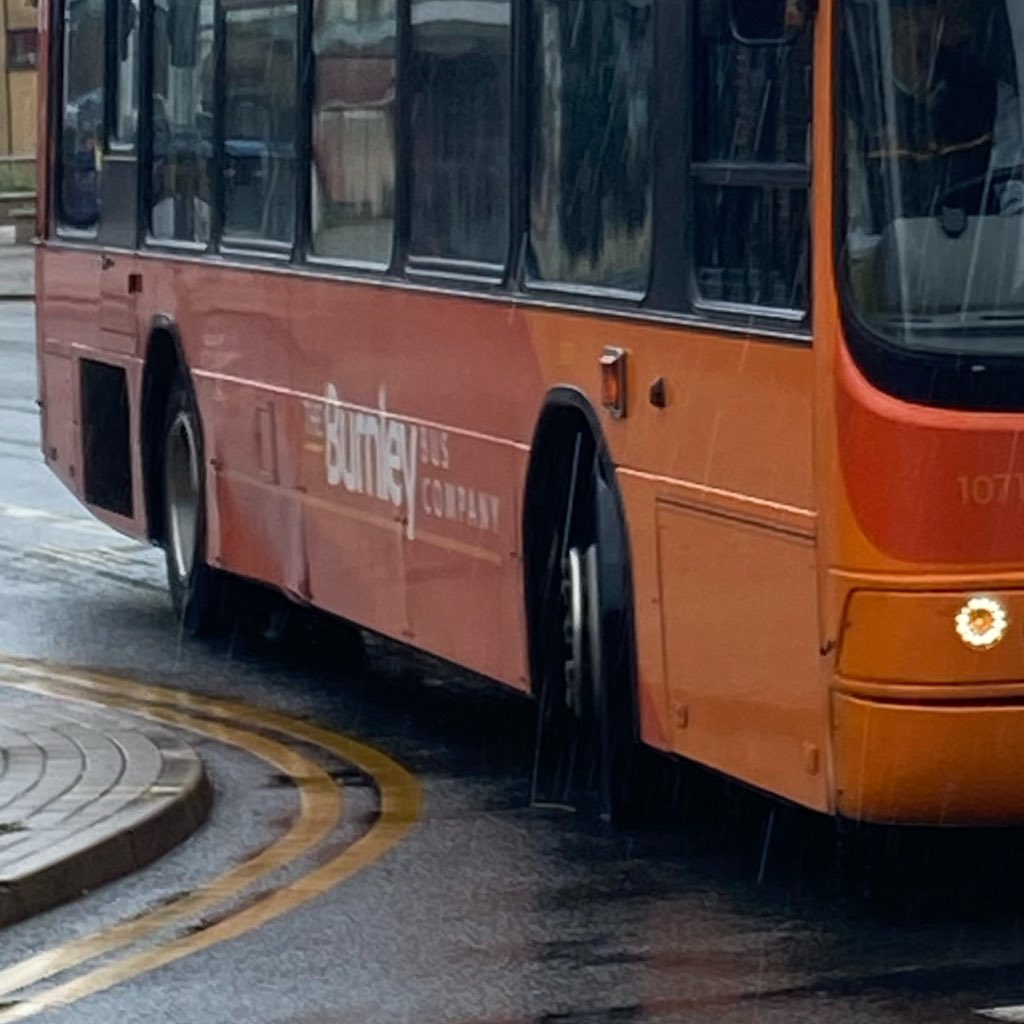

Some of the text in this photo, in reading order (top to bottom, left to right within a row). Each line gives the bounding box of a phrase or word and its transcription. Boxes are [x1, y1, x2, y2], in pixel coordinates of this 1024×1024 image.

[325, 383, 418, 540] Burnley
[419, 426, 449, 469] BUS
[422, 477, 499, 532] COMPANY
[956, 472, 1024, 505] 1071
